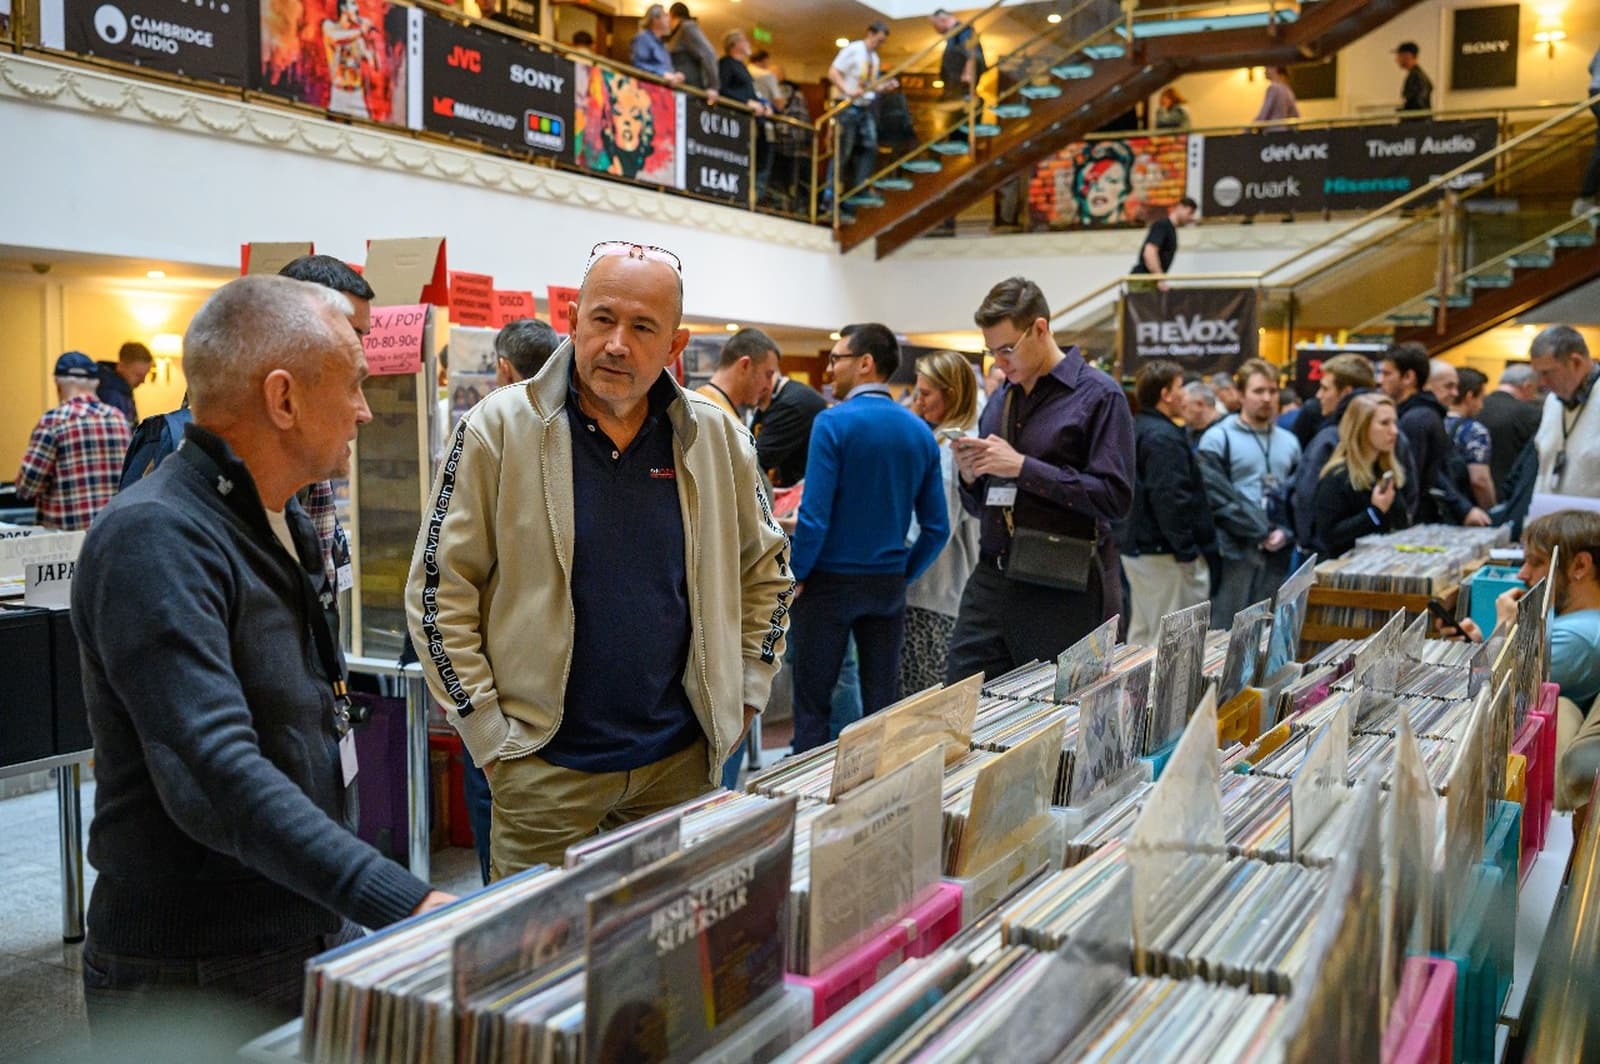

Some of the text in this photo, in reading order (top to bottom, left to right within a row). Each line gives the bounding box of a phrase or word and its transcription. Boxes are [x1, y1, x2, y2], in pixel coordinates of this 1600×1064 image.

[130, 15, 214, 48] CAMBRIDGE
[131, 32, 180, 54] AUDIO
[447, 45, 482, 74] JVC
[509, 64, 565, 94] SONY
[700, 110, 740, 138] QUAD
[1260, 142, 1329, 163] defunc
[1365, 134, 1477, 159] Tivoli Audio
[700, 166, 739, 194] LEAK
[1245, 176, 1301, 200] ruark
[1323, 175, 1411, 194] Hisense
[499, 295, 524, 306] DISCO
[395, 312, 423, 327] POP
[424, 429, 466, 576] Calvin Klein Jeans
[34, 561, 75, 586] JAPA
[441, 667, 470, 710] Calvin
